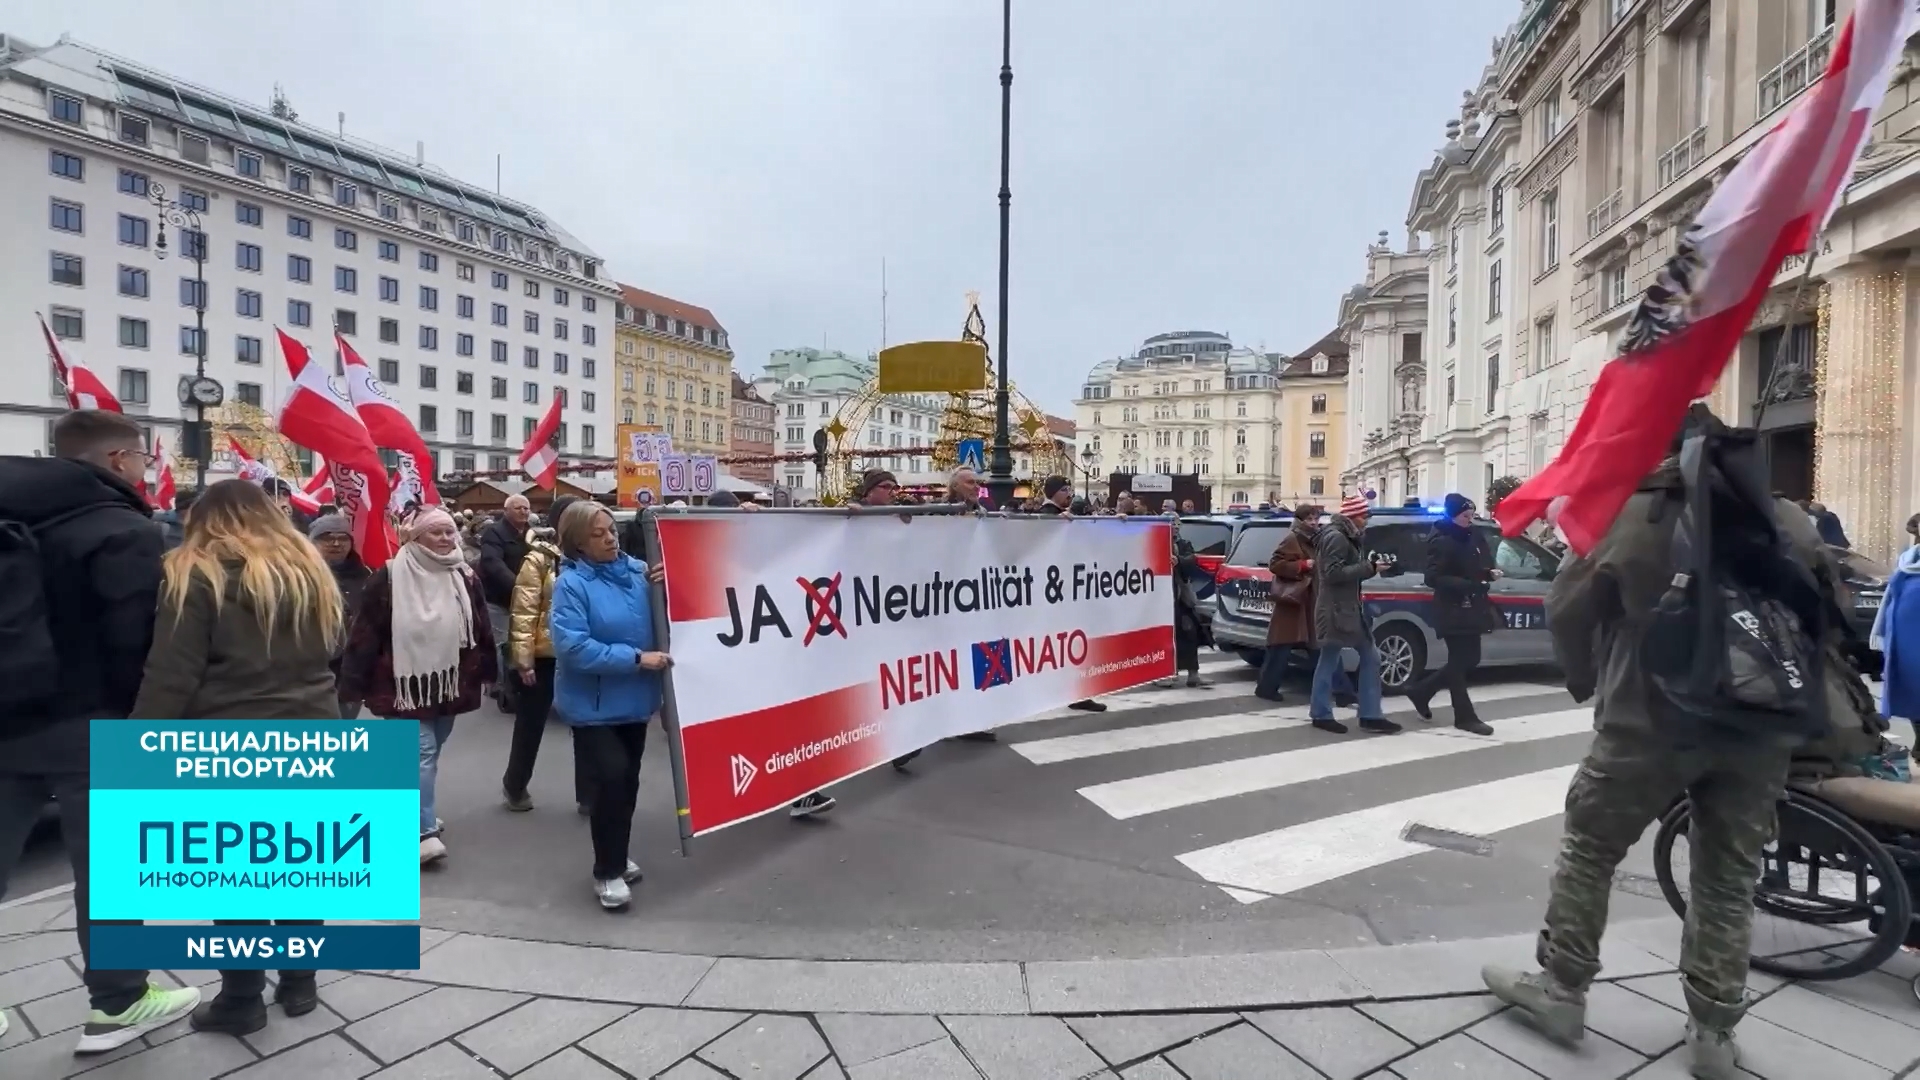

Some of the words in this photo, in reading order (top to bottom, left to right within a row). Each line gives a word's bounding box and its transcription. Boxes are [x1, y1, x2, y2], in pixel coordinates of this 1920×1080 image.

[717, 583, 793, 648] JA
[853, 566, 1033, 627] Neutralität
[1044, 565, 1065, 603] &
[1073, 561, 1155, 601] Frieden
[879, 649, 960, 710] NEIN
[1013, 629, 1088, 677] NATO
